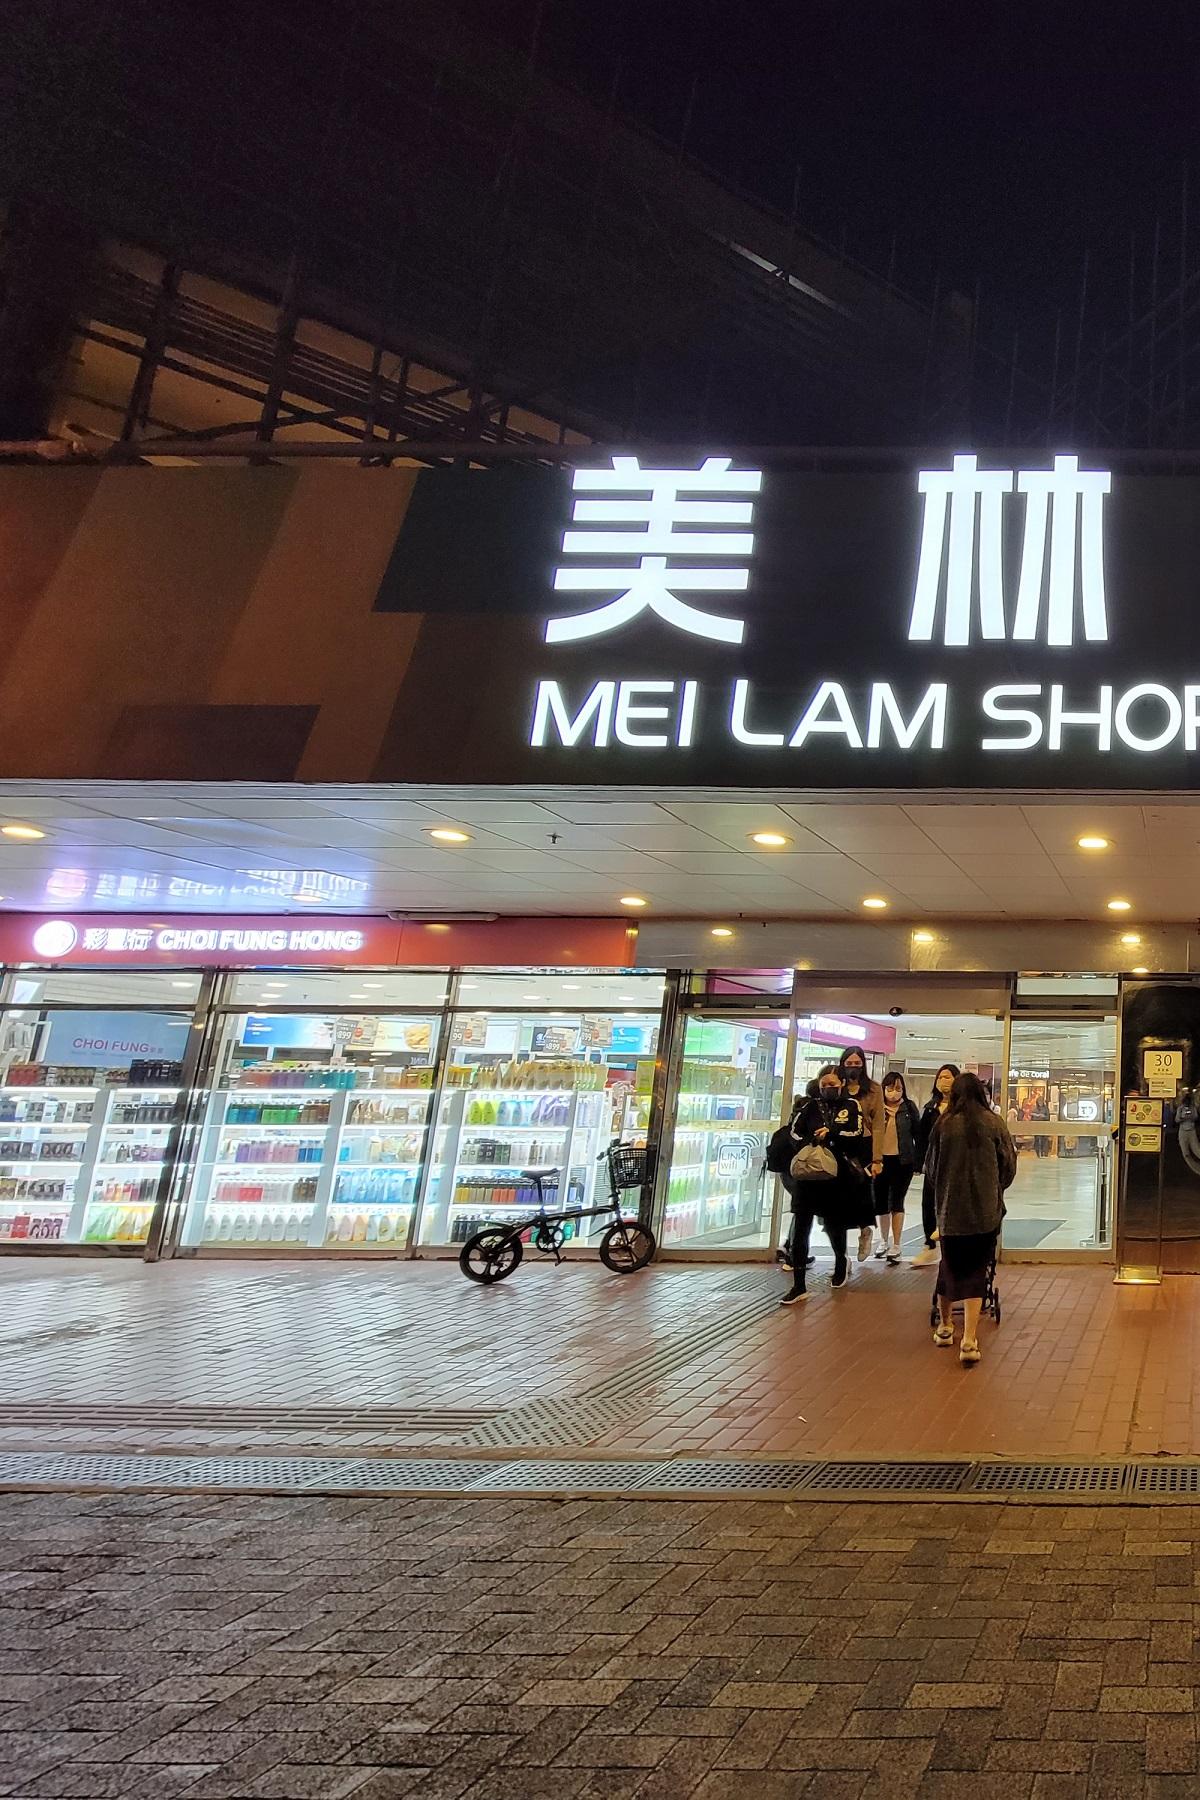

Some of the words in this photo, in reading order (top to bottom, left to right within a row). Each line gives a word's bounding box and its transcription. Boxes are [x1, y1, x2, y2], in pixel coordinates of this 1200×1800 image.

[531, 681, 698, 747] MEI
[732, 680, 948, 749] LAM
[83, 927, 154, 951] 彩行
[157, 929, 218, 951] CHOI
[219, 929, 288, 951] FUNG
[289, 930, 363, 951] HONG
[72, 1038, 109, 1050] CHOI
[111, 1041, 149, 1053] FUNG
[1155, 1054, 1172, 1067] 30
[1031, 1070, 1050, 1078] coral
